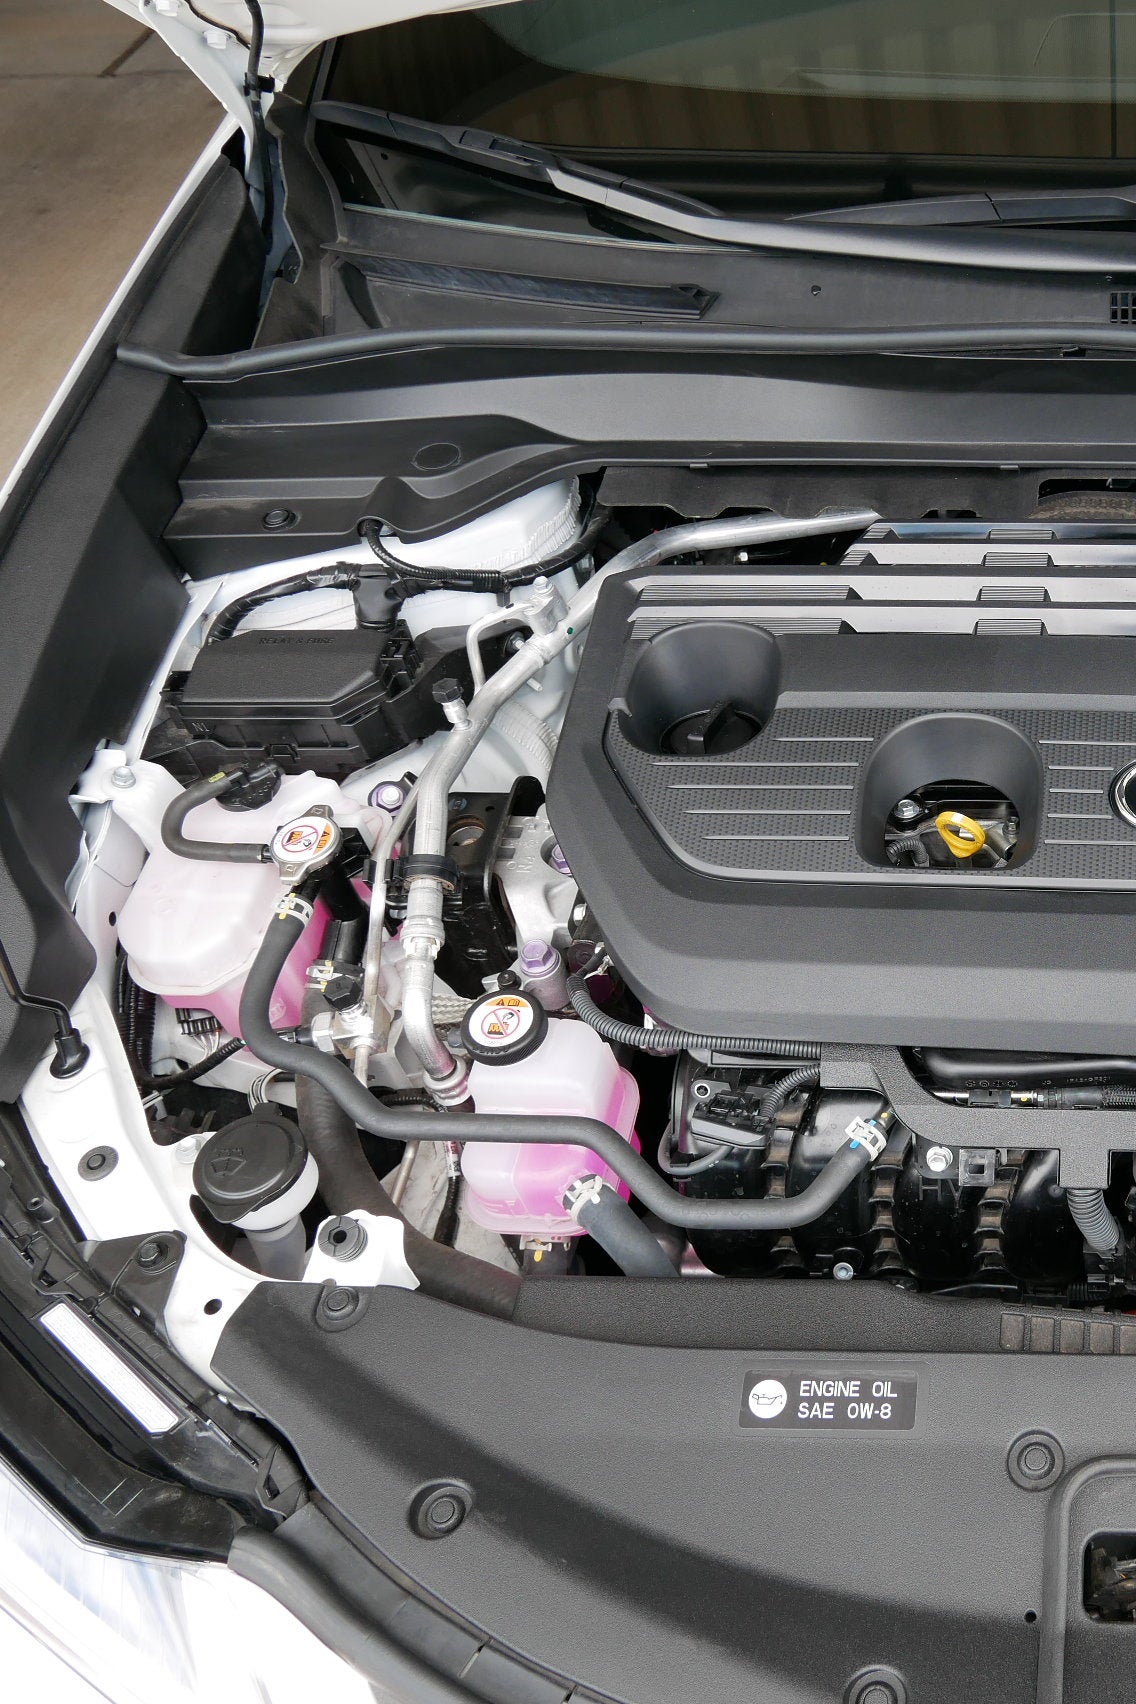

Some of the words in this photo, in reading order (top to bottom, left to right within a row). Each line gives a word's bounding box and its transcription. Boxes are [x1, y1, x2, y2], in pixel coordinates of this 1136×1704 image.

[799, 1380, 861, 1398] ENGINE
[872, 1381, 898, 1398] OIL
[797, 1402, 835, 1419] SAE
[847, 1403, 893, 1420] 0W-8
